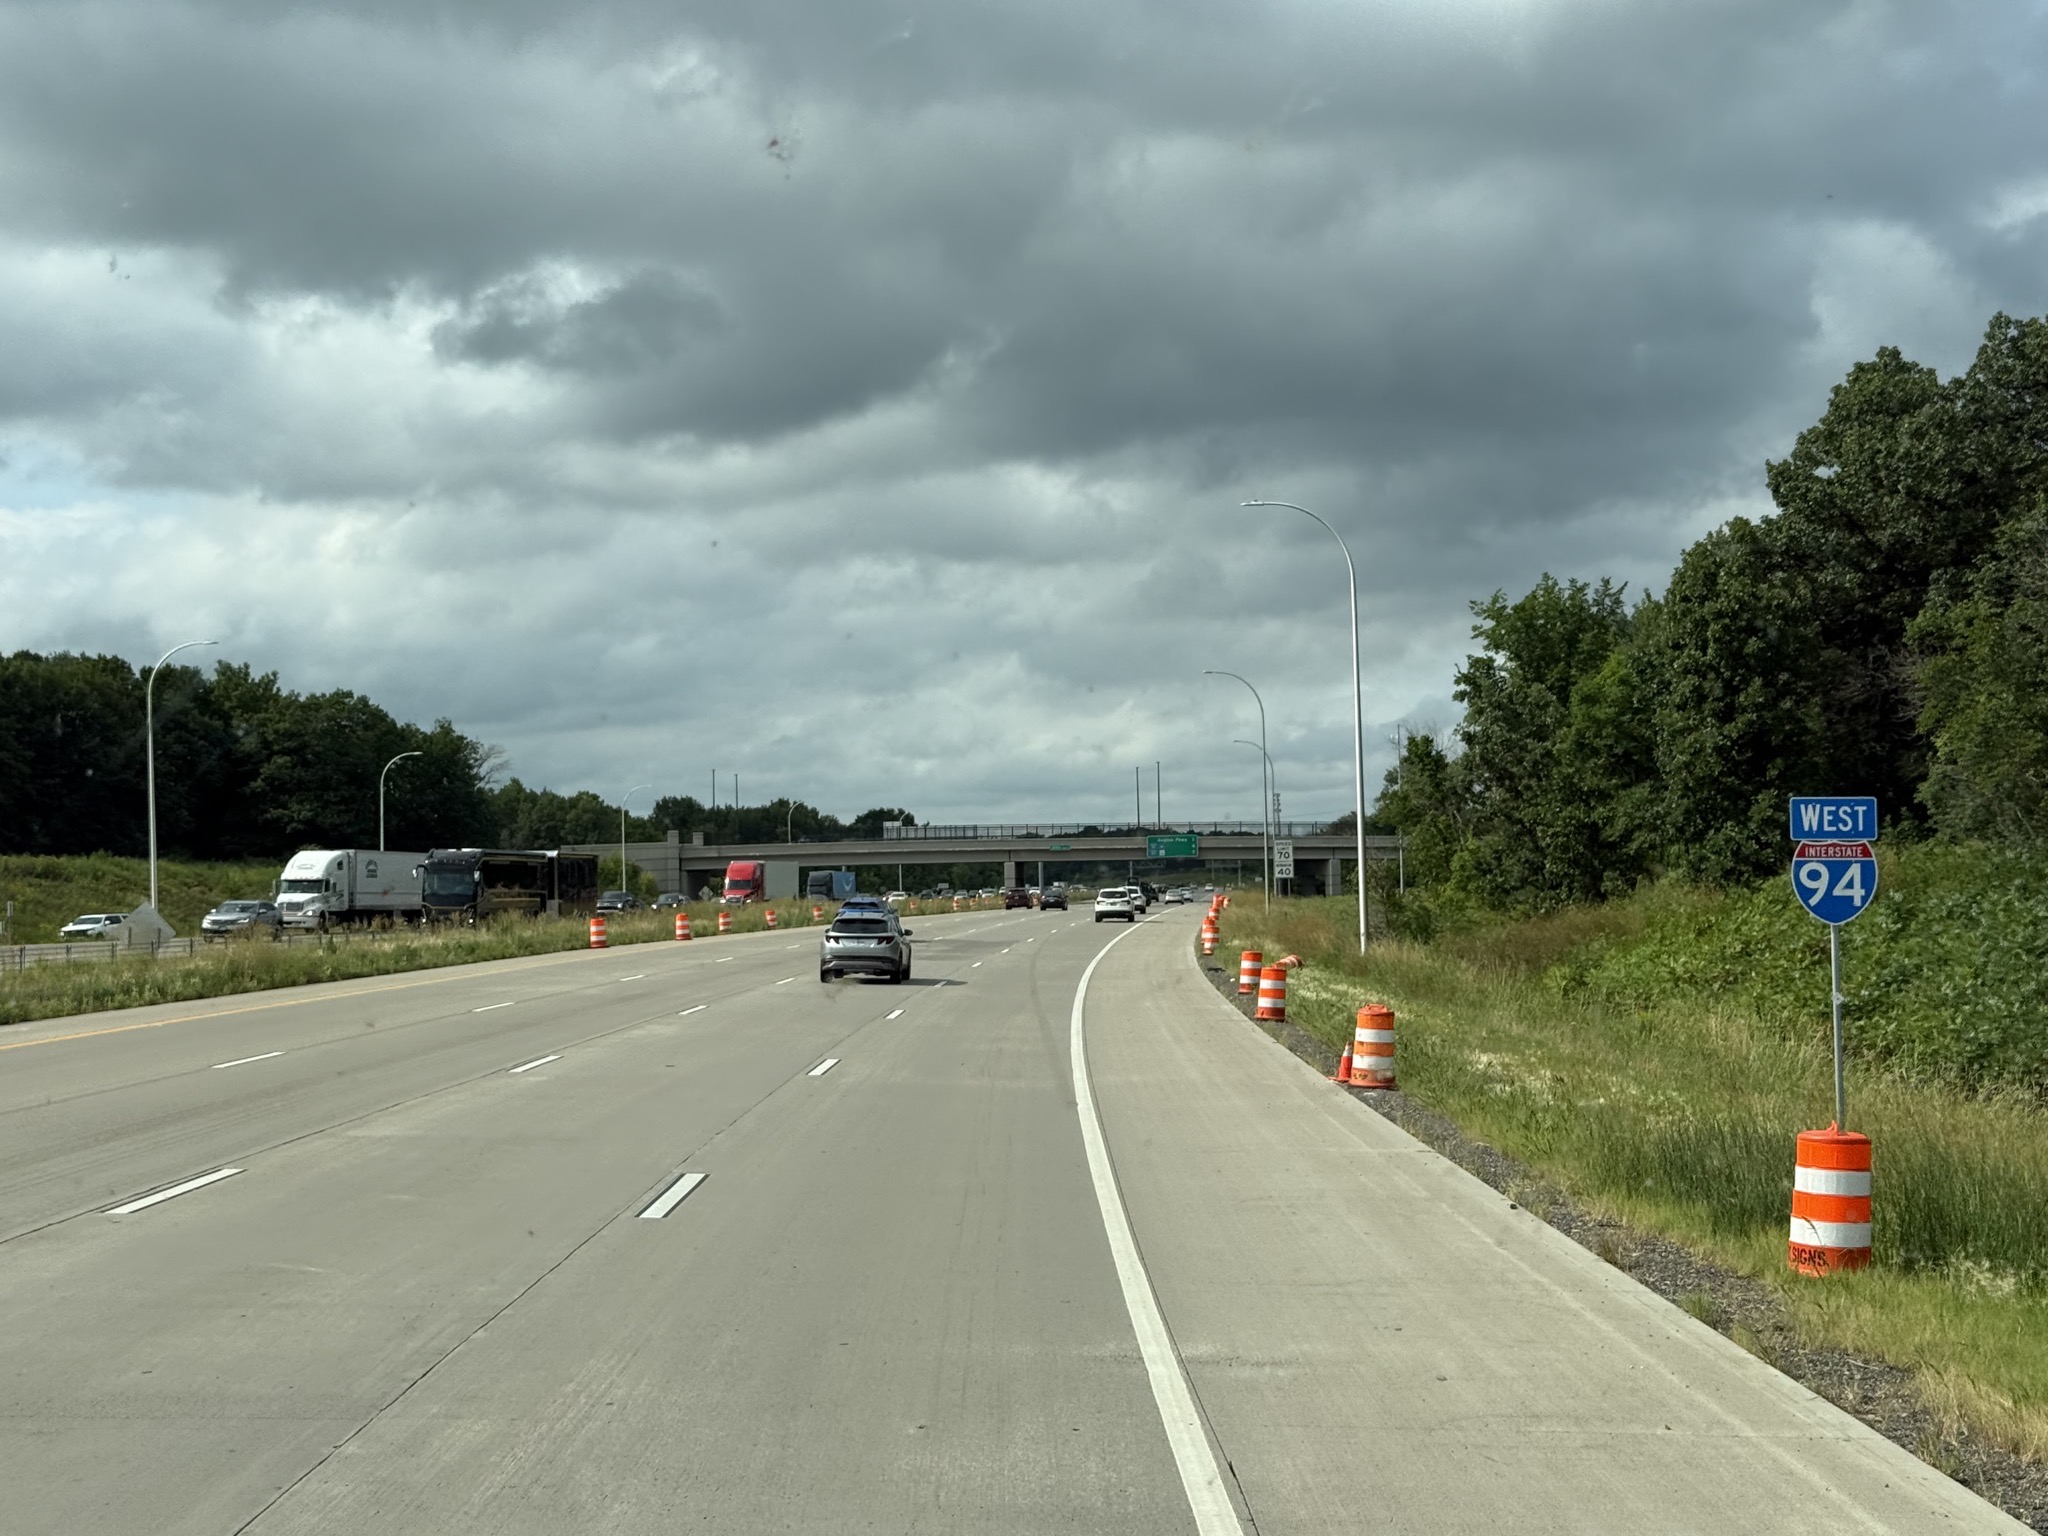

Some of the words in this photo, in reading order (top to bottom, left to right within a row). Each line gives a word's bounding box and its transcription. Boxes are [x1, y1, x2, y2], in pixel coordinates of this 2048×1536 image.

[1800, 804, 1867, 831] WEST
[1277, 851, 1290, 859] 70
[1805, 846, 1863, 857] INTERSTATE
[1277, 868, 1291, 876] 40
[1799, 862, 1865, 907] 94
[1792, 1246, 1826, 1266] SIGNS
